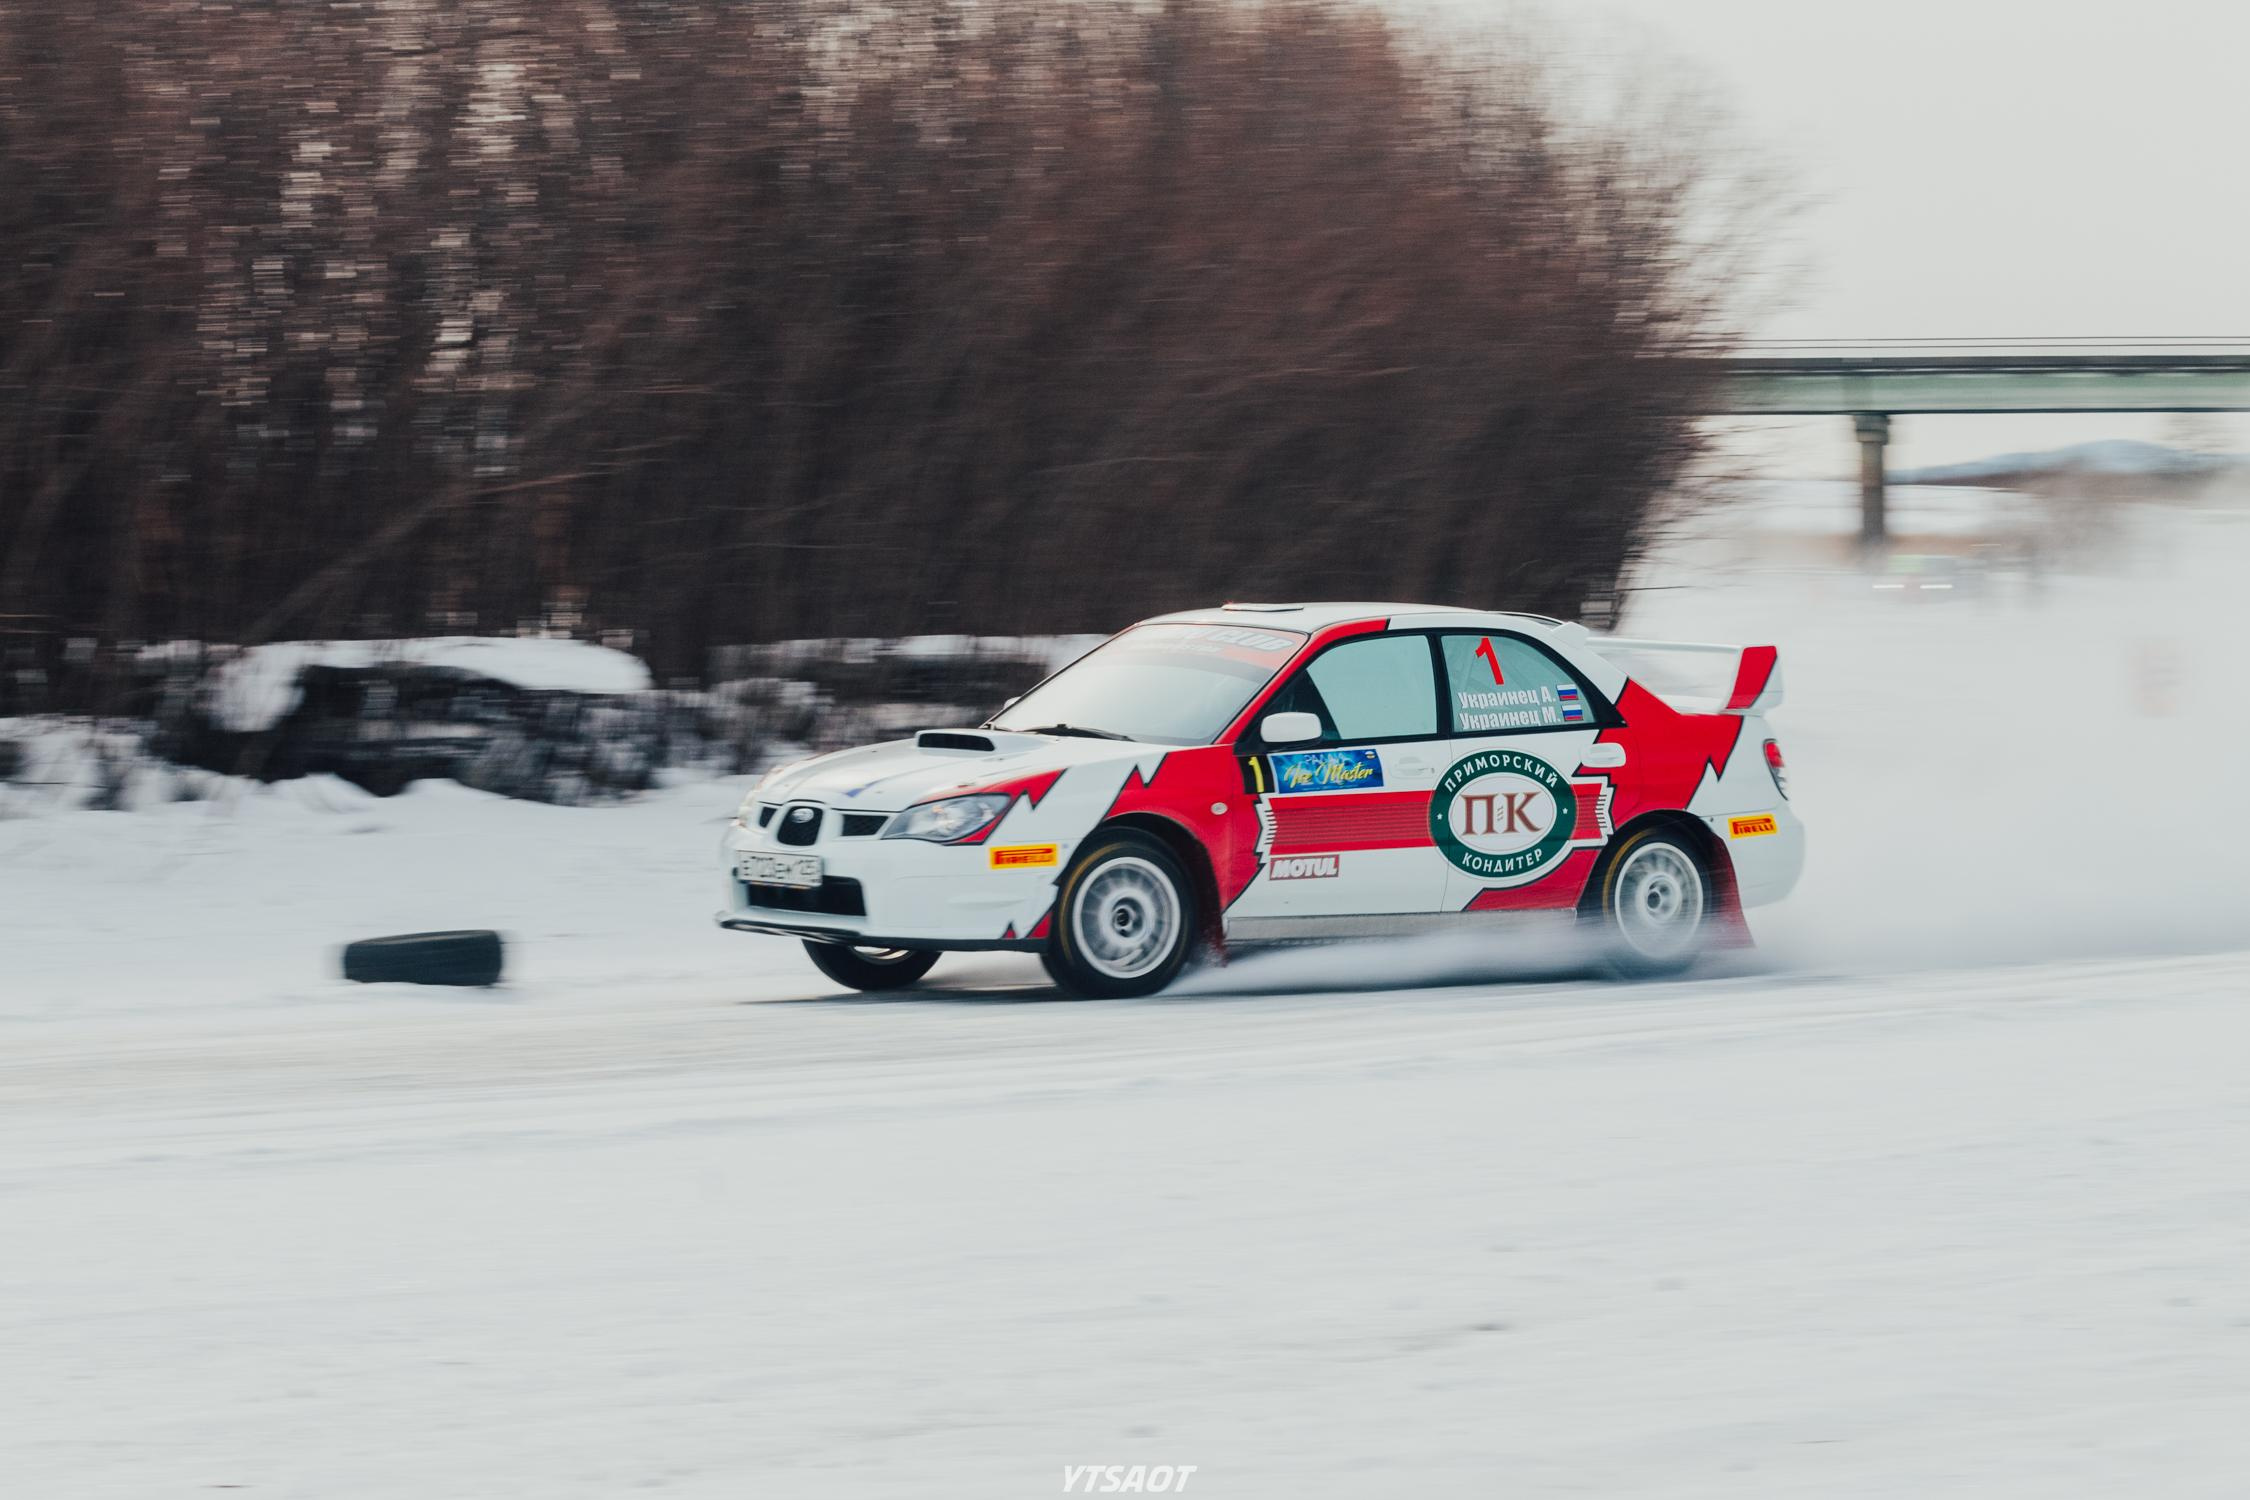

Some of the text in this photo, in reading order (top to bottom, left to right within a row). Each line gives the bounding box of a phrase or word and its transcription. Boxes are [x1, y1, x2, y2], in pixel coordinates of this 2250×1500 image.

[1475, 636, 1504, 685] 1
[1458, 686, 1556, 709] Украинец А.
[1459, 706, 1561, 730] Украинец М.
[1248, 756, 1265, 793] 1
[1444, 754, 1558, 793] ПРИМОРСКИЙ
[1460, 791, 1543, 836] ПК
[1732, 818, 1774, 835] PIRELLI
[1271, 857, 1338, 878] MOTUL
[1462, 848, 1542, 873] КОНДИТЕР
